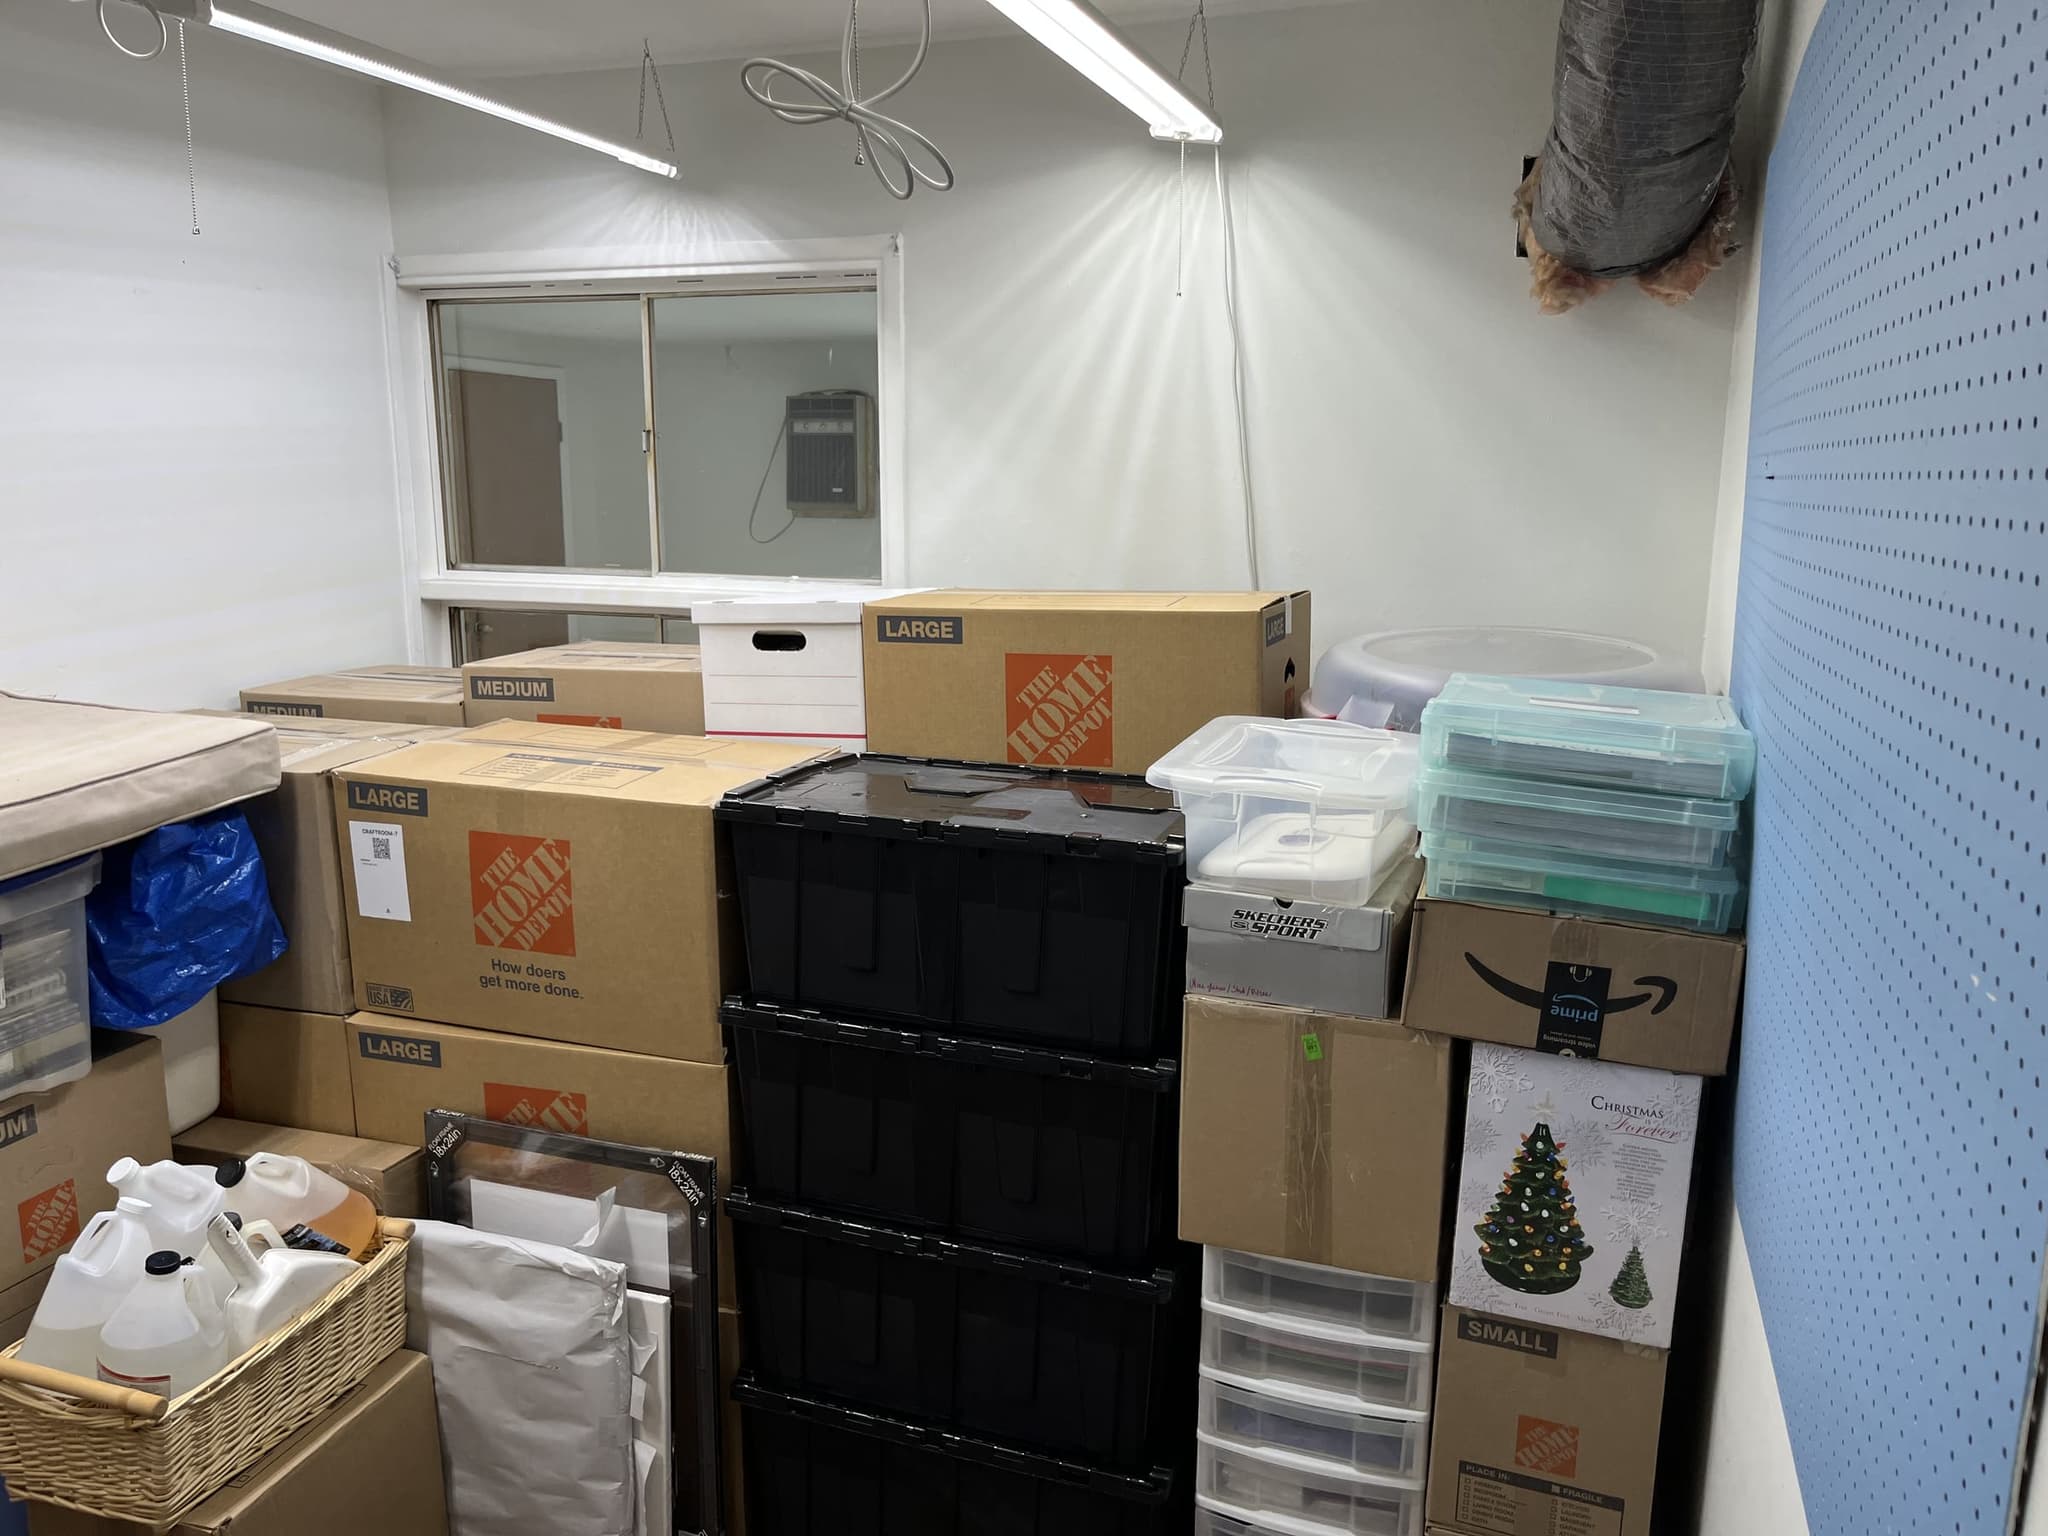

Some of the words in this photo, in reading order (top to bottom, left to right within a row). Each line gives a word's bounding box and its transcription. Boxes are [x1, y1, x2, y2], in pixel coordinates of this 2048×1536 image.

[885, 620, 954, 639] LARGE
[477, 680, 548, 697] MEDIUM
[1016, 665, 1060, 709] THE
[1006, 655, 1112, 763] HOME
[1048, 697, 1112, 765] DEPOT
[354, 786, 420, 811] LARGE
[480, 847, 521, 890] THE
[474, 838, 571, 946] HOME
[513, 883, 572, 951] DEPOT
[1232, 909, 1328, 929] SKECHERS
[1250, 922, 1322, 939] SPORT
[491, 958, 522, 974] How
[526, 963, 567, 981] doers
[479, 975, 502, 989] get
[505, 978, 541, 993] more
[369, 990, 392, 1008] USA
[1550, 1005, 1599, 1022] prime
[366, 1037, 433, 1062] LARGE
[1606, 1115, 1681, 1139] Forever
[668, 1165, 700, 1206] 18x24in
[1467, 1322, 1548, 1351] SMALL
[1465, 1464, 1495, 1478] PLACE
[1562, 1488, 1603, 1504] FRAGILE
